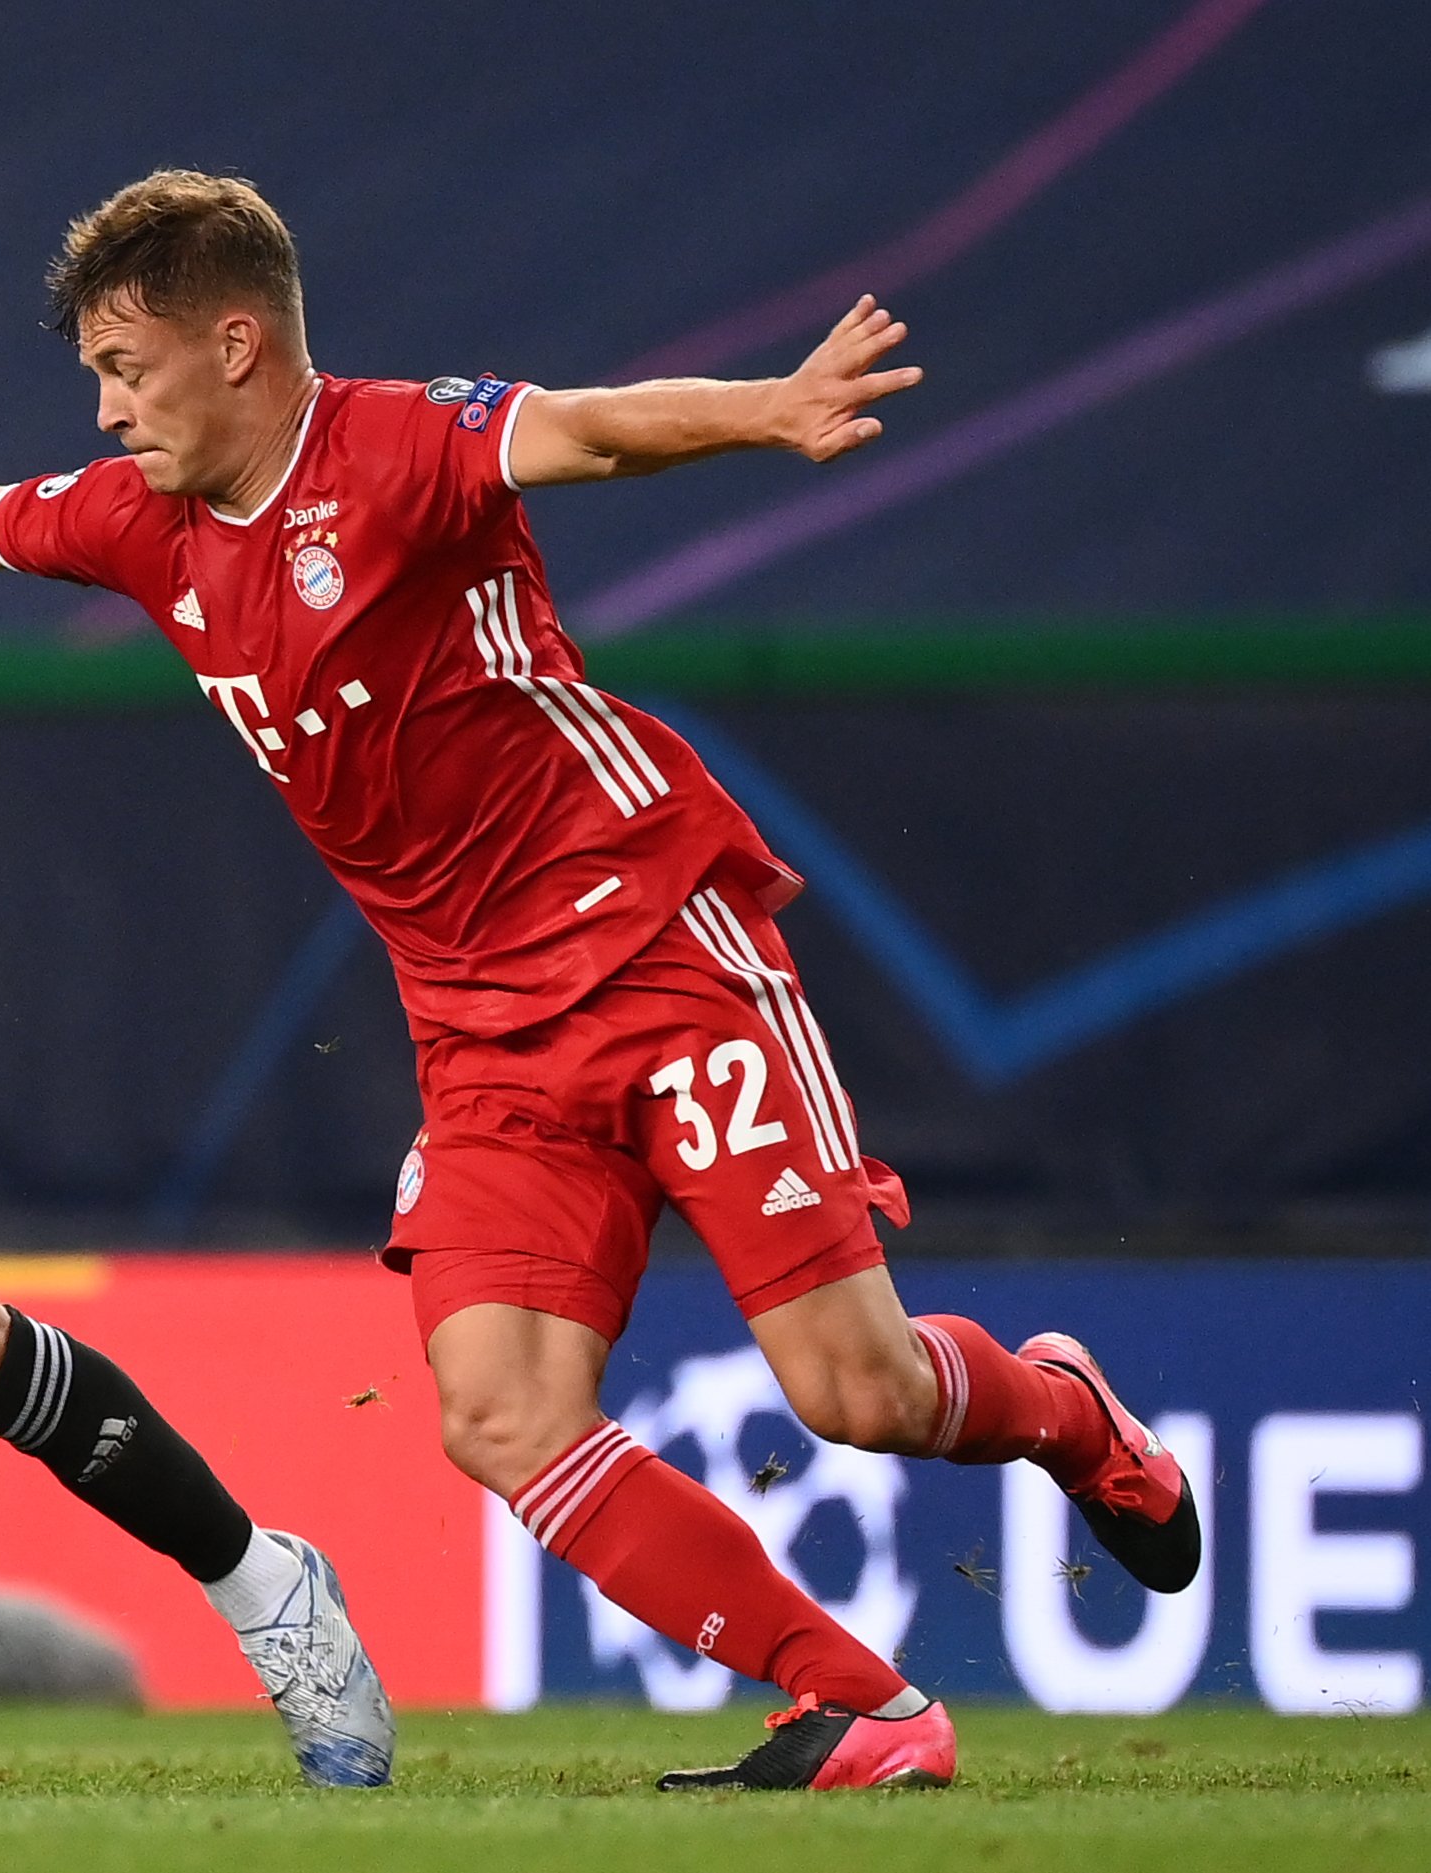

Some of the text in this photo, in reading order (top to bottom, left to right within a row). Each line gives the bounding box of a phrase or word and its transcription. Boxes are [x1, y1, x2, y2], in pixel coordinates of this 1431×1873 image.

[283, 500, 338, 529] Danke
[300, 550, 336, 570] BAYERN
[649, 1039, 788, 1172] 32
[761, 1191, 823, 1217] adidas
